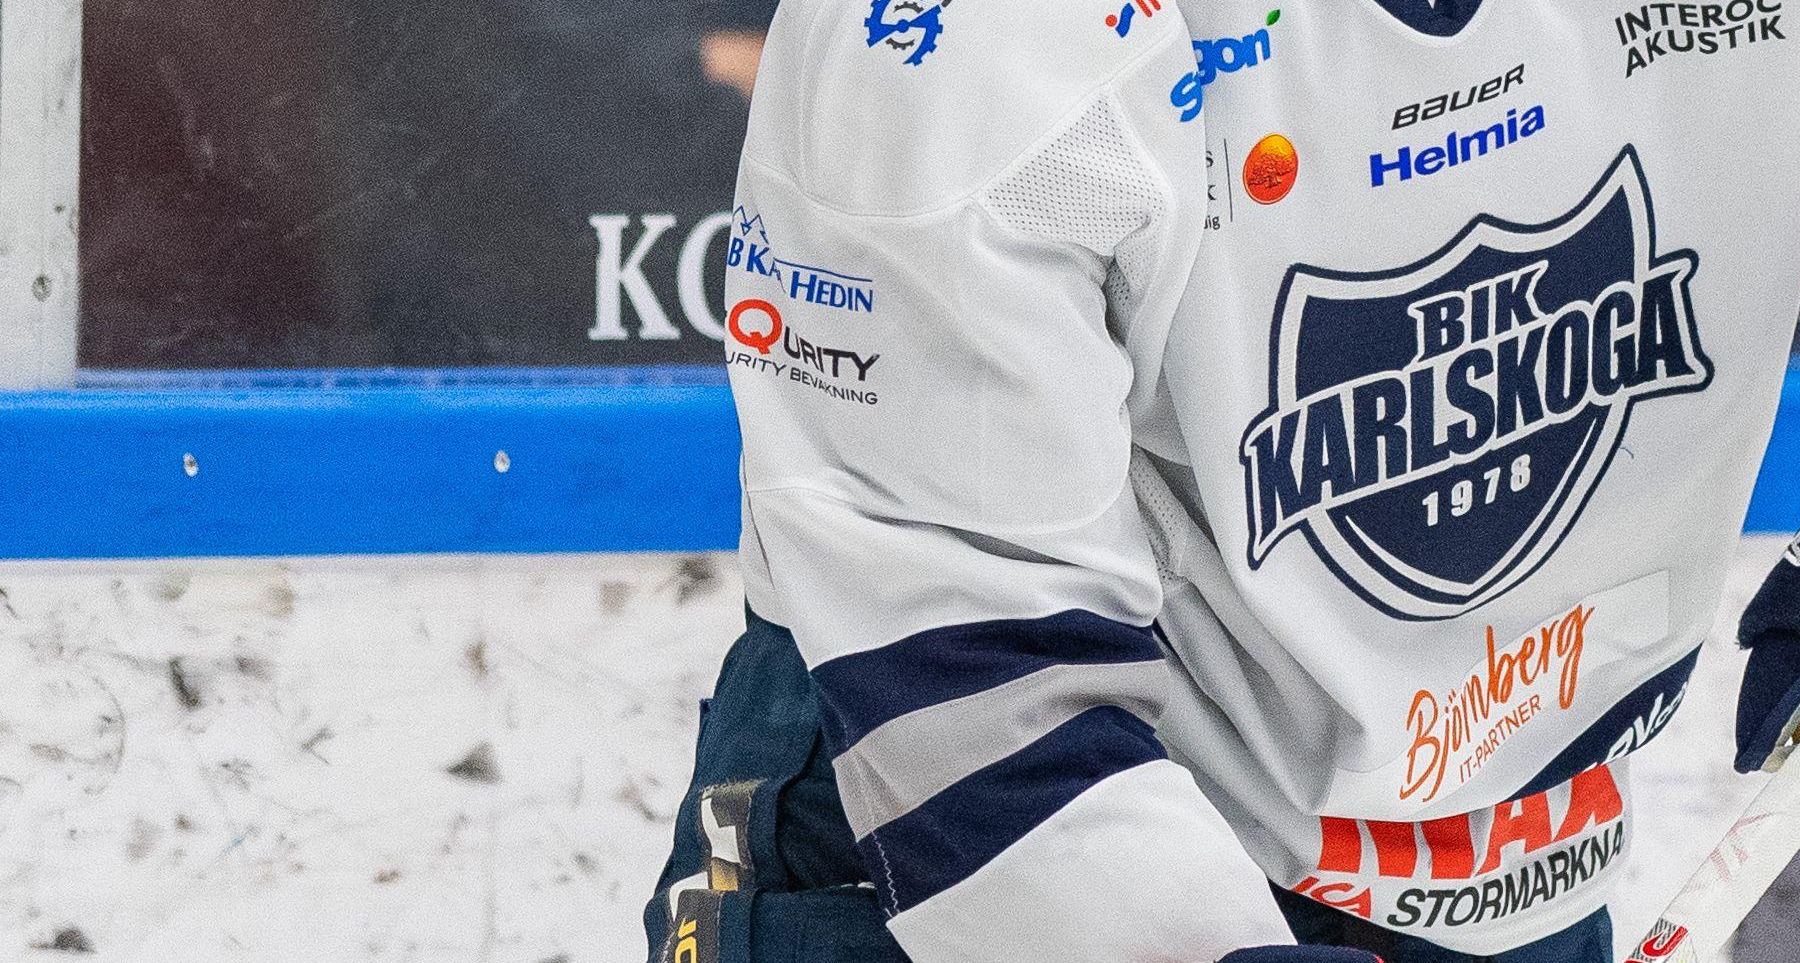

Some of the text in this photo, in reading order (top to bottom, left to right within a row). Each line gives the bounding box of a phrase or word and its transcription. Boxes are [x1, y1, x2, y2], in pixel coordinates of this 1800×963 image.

[1625, 15, 1787, 79] AKUSTIK
[1370, 105, 1546, 188] Helmia
[790, 270, 873, 313] HEDIN
[1413, 266, 1546, 363] BIK
[1251, 271, 1697, 544] KARLSKOGA
[1421, 454, 1532, 527] 1978
[1399, 603, 1596, 803] Björnberg
[1458, 694, 1542, 783] IT-PARTNER
